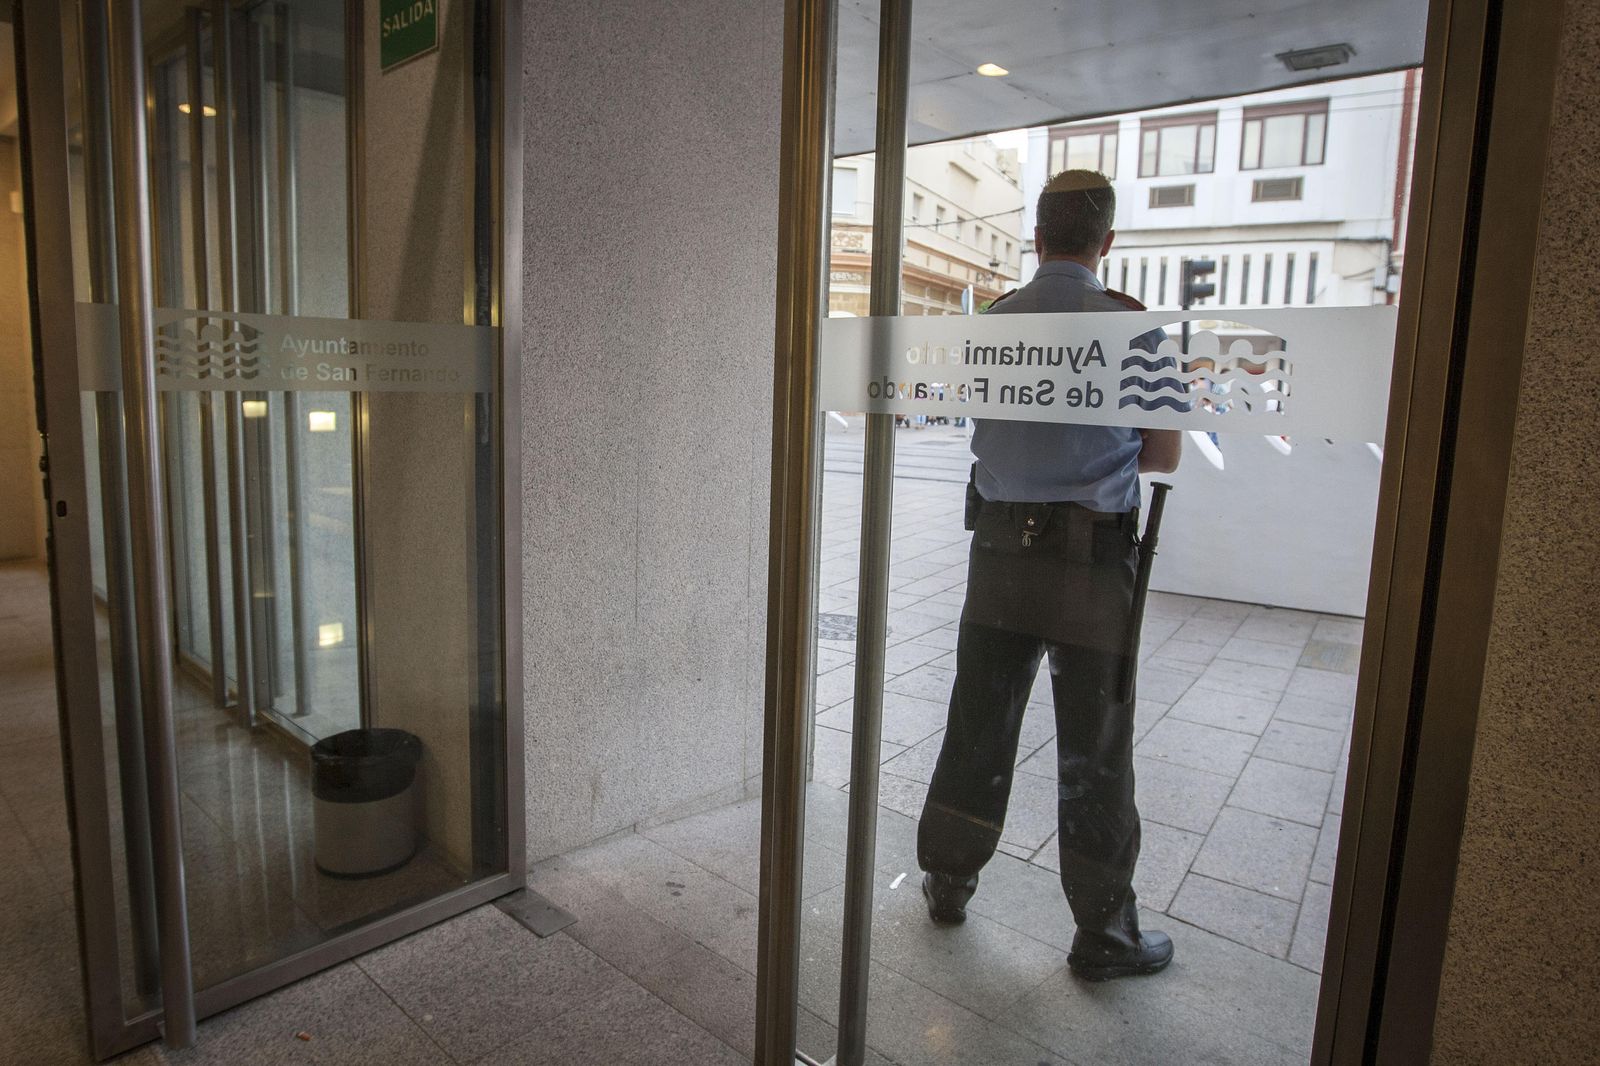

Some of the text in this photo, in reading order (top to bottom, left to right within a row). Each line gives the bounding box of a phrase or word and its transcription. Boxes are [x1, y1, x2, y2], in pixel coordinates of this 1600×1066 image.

[383, 0, 433, 38] SALIDA
[280, 362, 308, 381] de
[316, 362, 357, 382] San
